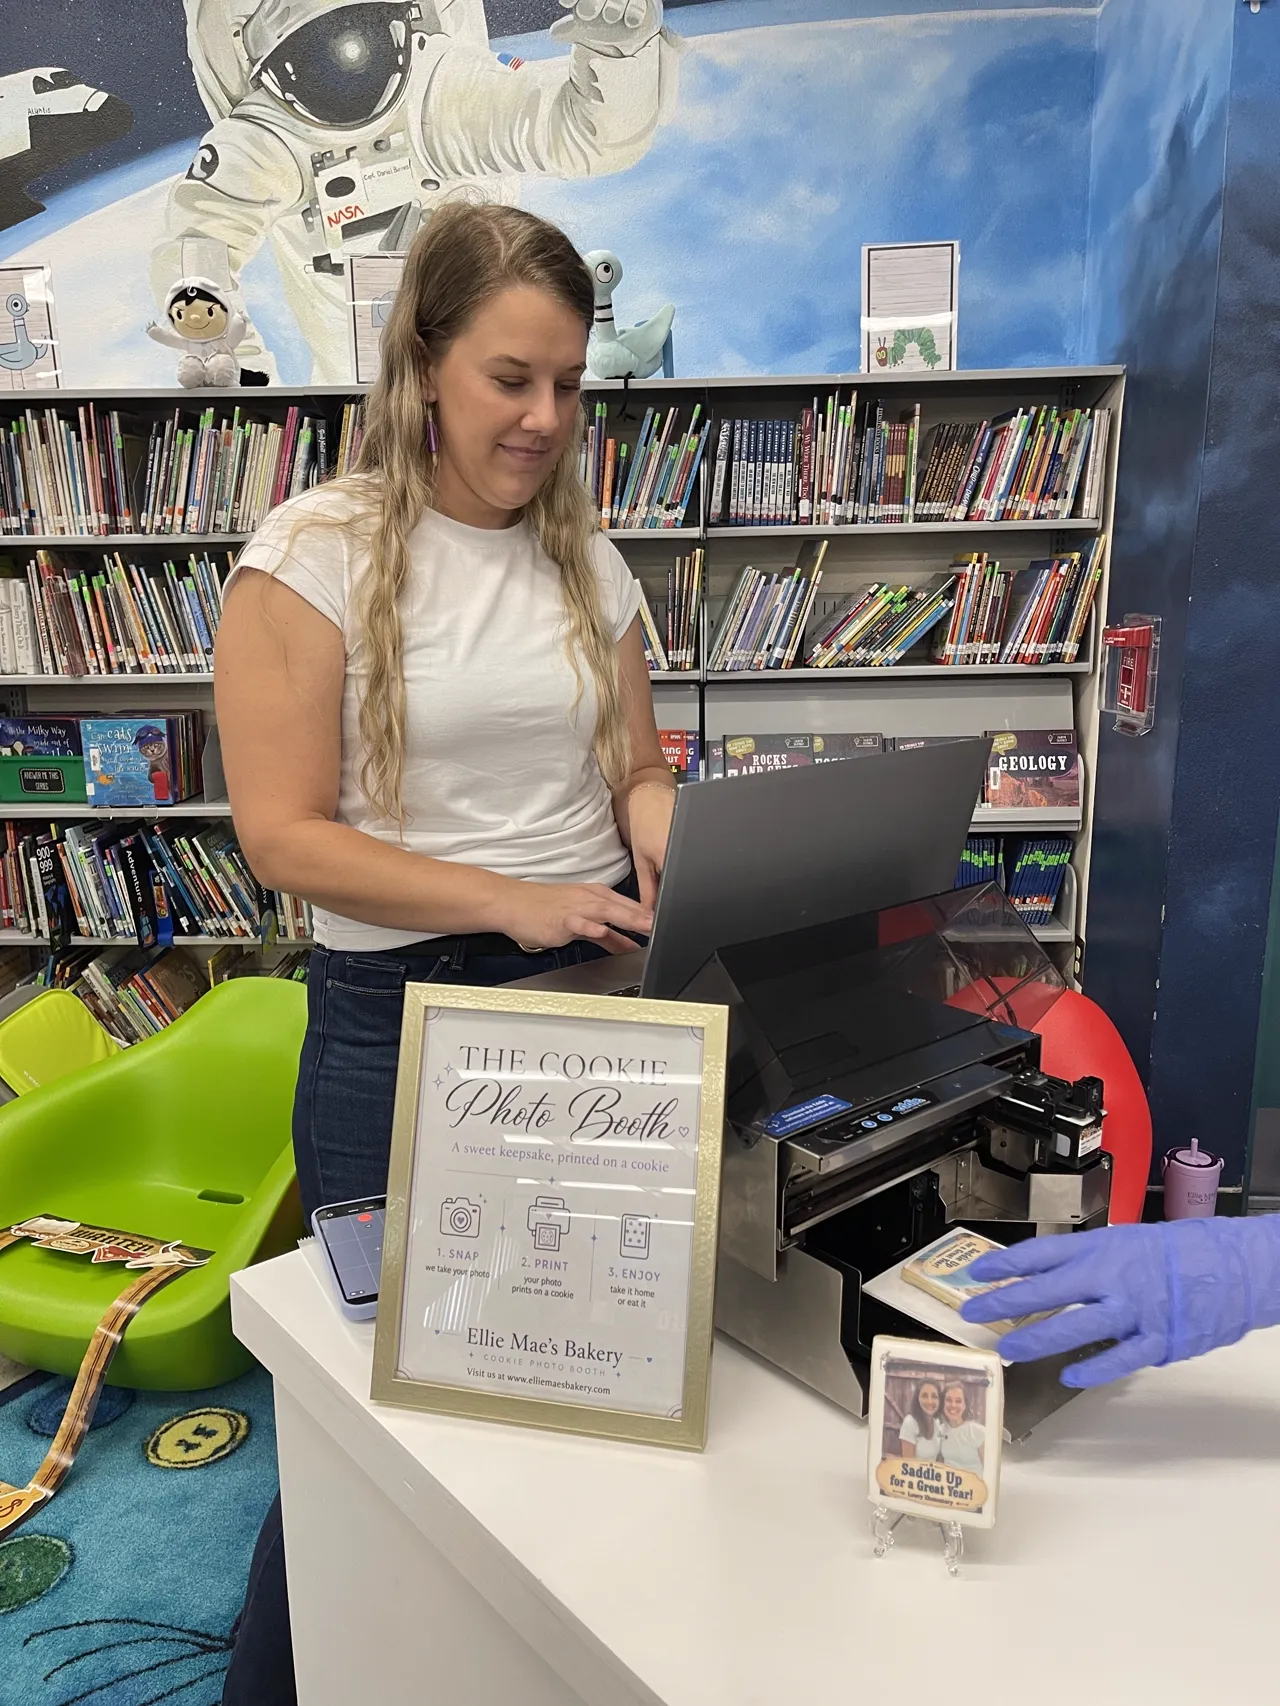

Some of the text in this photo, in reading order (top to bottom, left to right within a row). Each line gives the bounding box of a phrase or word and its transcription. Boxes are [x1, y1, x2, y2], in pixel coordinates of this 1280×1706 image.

[327, 205, 364, 228] NASA
[804, 434, 810, 443] WE
[13, 604, 22, 620] Every
[14, 620, 23, 635] Thing
[27, 725, 49, 737] Milky
[51, 725, 66, 737] Way
[107, 727, 132, 741] cats
[98, 742, 131, 756] swim
[753, 754, 787, 765] ROCKS
[999, 755, 1067, 771] GEOLOGY
[36, 846, 54, 860] 900-
[40, 859, 53, 873] 999
[126, 850, 142, 902] Adventure
[460, 1046, 668, 1086] THE COOKIE
[445, 1077, 679, 1143] Photo Booth
[451, 1142, 670, 1173] A sweet keepsake, printed on a cookie
[437, 1248, 480, 1262] 1. SNAP
[956, 1248, 980, 1262] Saddle
[437, 1264, 452, 1274] take
[453, 1266, 468, 1278] your
[469, 1268, 490, 1279] photo
[521, 1257, 569, 1272] 2. PRINT
[946, 1261, 960, 1269] Up
[523, 1276, 562, 1288] your photo
[608, 1267, 661, 1282] 3. ENJOY
[511, 1285, 532, 1296] prints
[550, 1289, 574, 1300] cookie
[610, 1285, 656, 1298] take it home
[627, 1299, 639, 1307] eat
[640, 1299, 647, 1308] it
[467, 1327, 624, 1369] Ellie Mae's Bakery
[484, 1354, 606, 1377] COOKIE PHOTO BOOTH
[467, 1367, 611, 1395] Visit us at www.elliemaesbakery.com
[901, 1462, 963, 1488] Saddle Up
[890, 1474, 973, 1500] for a Great Year!
